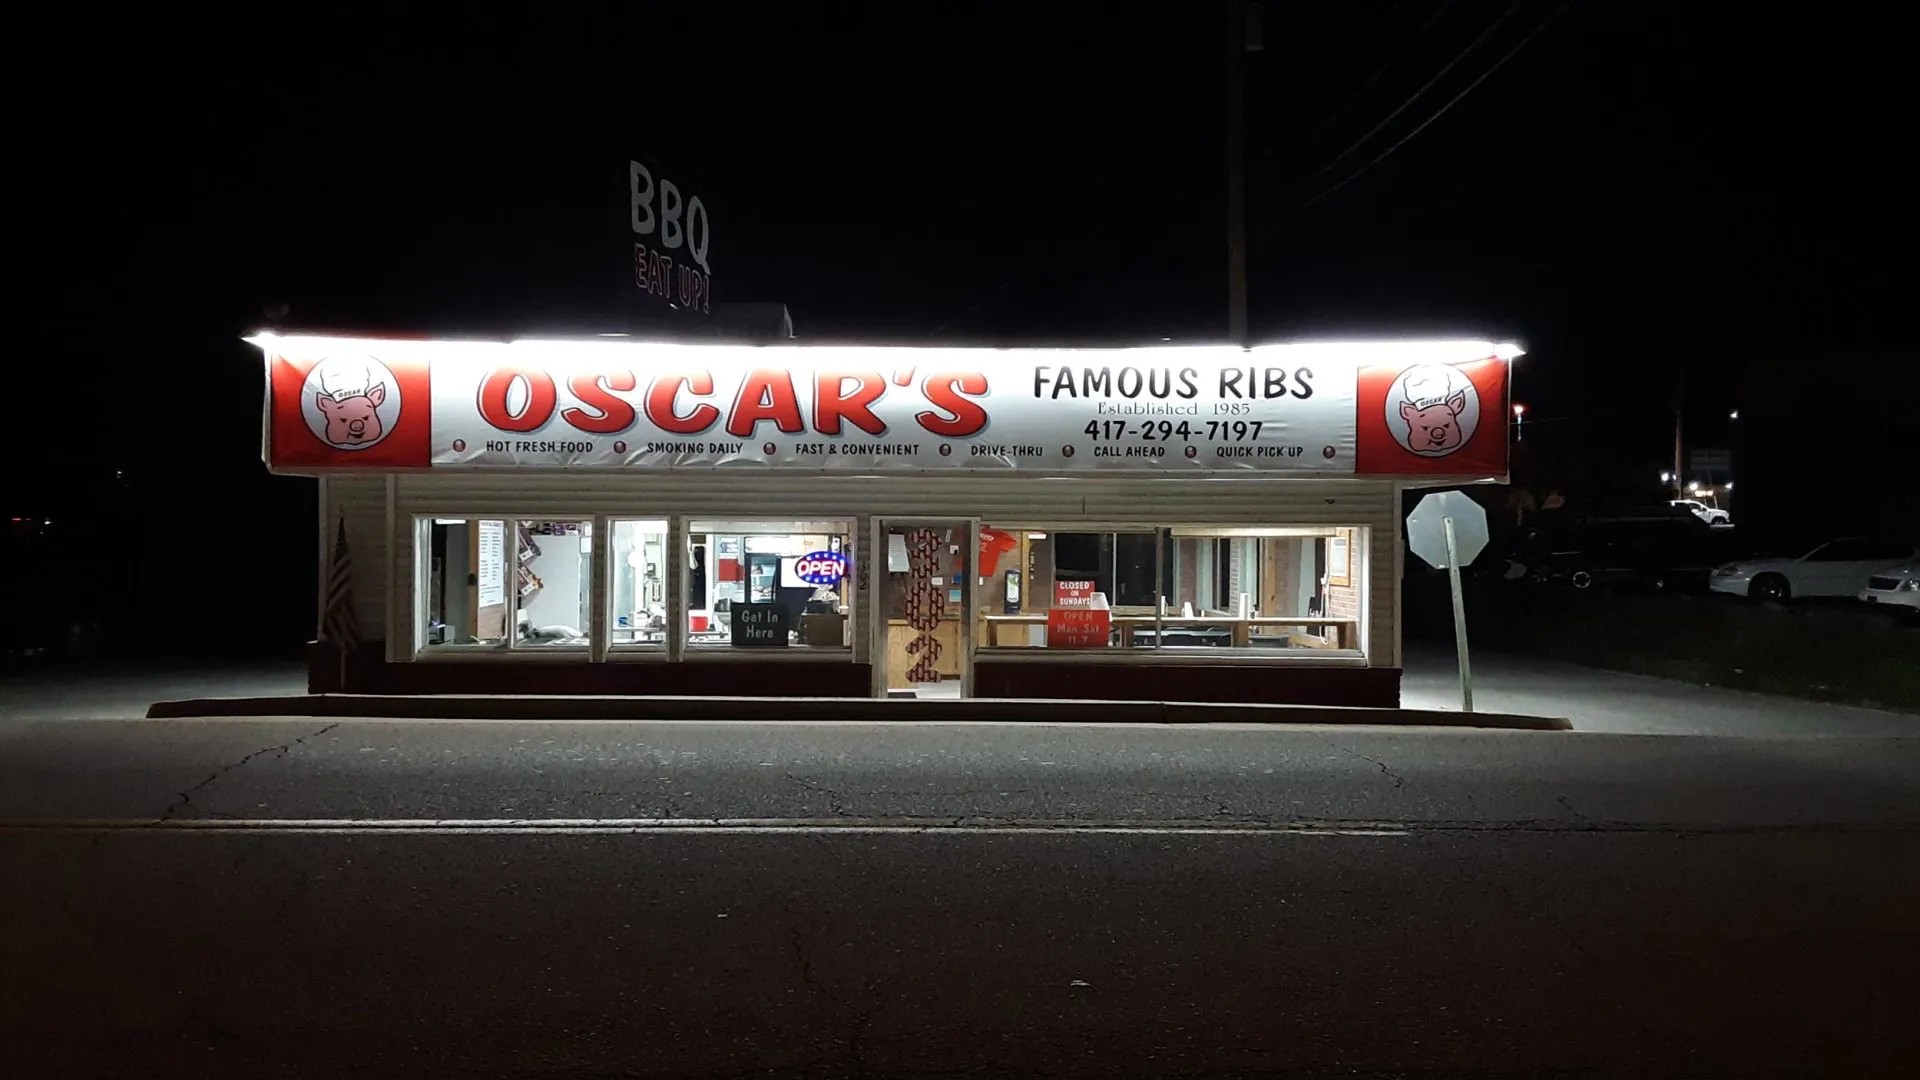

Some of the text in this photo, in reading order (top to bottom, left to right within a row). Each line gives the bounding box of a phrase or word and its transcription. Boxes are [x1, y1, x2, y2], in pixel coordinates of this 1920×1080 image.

[630, 160, 711, 275] BBQ
[635, 243, 710, 314] EAT UP!
[1034, 366, 1314, 400] FAMOUS RIBS
[477, 366, 989, 437] OSCAR'S
[1098, 402, 1250, 416] Established 1985
[1084, 420, 1263, 442] 417-294-7197
[486, 441, 593, 453] HOT FRESH FOOD
[647, 442, 743, 454] SMOKING DAILY
[795, 443, 919, 456] FAST & CONVENIENT
[971, 445, 1043, 457] DRIVE-THRU
[1094, 446, 1165, 458] CALL AHEAD
[1216, 446, 1304, 458] QUICK PICK UP
[797, 559, 845, 577] OPEN
[1059, 581, 1090, 590] CLOSED
[1059, 597, 1091, 606] SUNDAYS
[741, 610, 779, 623] Get In
[1064, 611, 1093, 621] OPEN
[746, 625, 774, 639] Here
